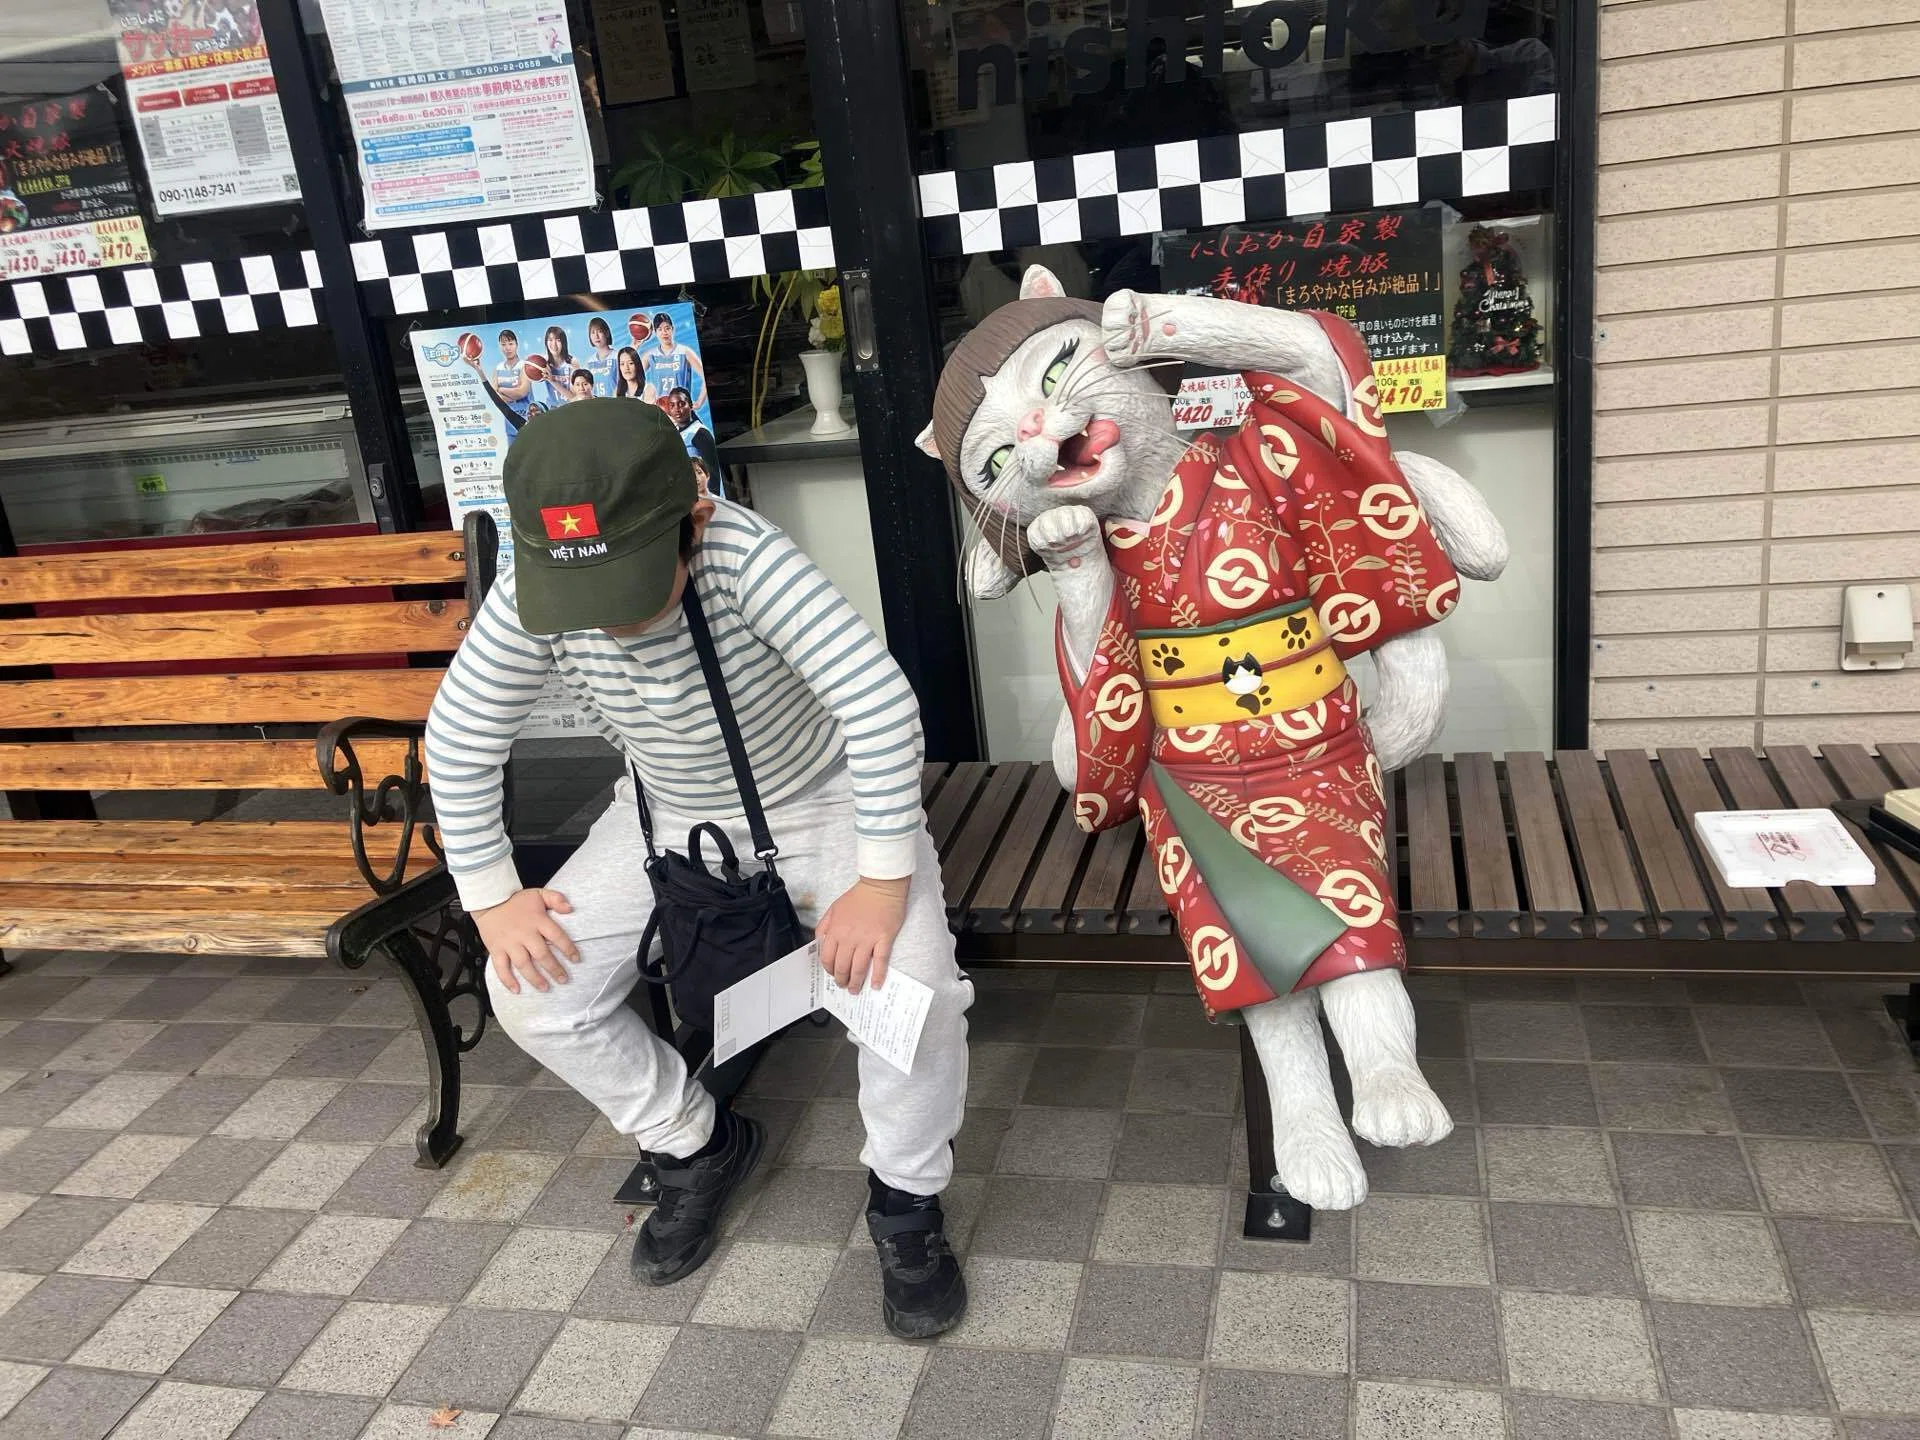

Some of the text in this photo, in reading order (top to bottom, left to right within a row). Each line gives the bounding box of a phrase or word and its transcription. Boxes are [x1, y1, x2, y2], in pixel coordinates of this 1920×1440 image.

[121, 20, 214, 60] サッカー
[158, 182, 237, 203] 090-1148-7341
[1211, 251, 1390, 293] 手作り 焼豚
[661, 376, 675, 394] 27
[1379, 385, 1424, 406] ¥470
[1174, 405, 1213, 424] ¥420
[549, 542, 608, 562] VIỆT NAM
